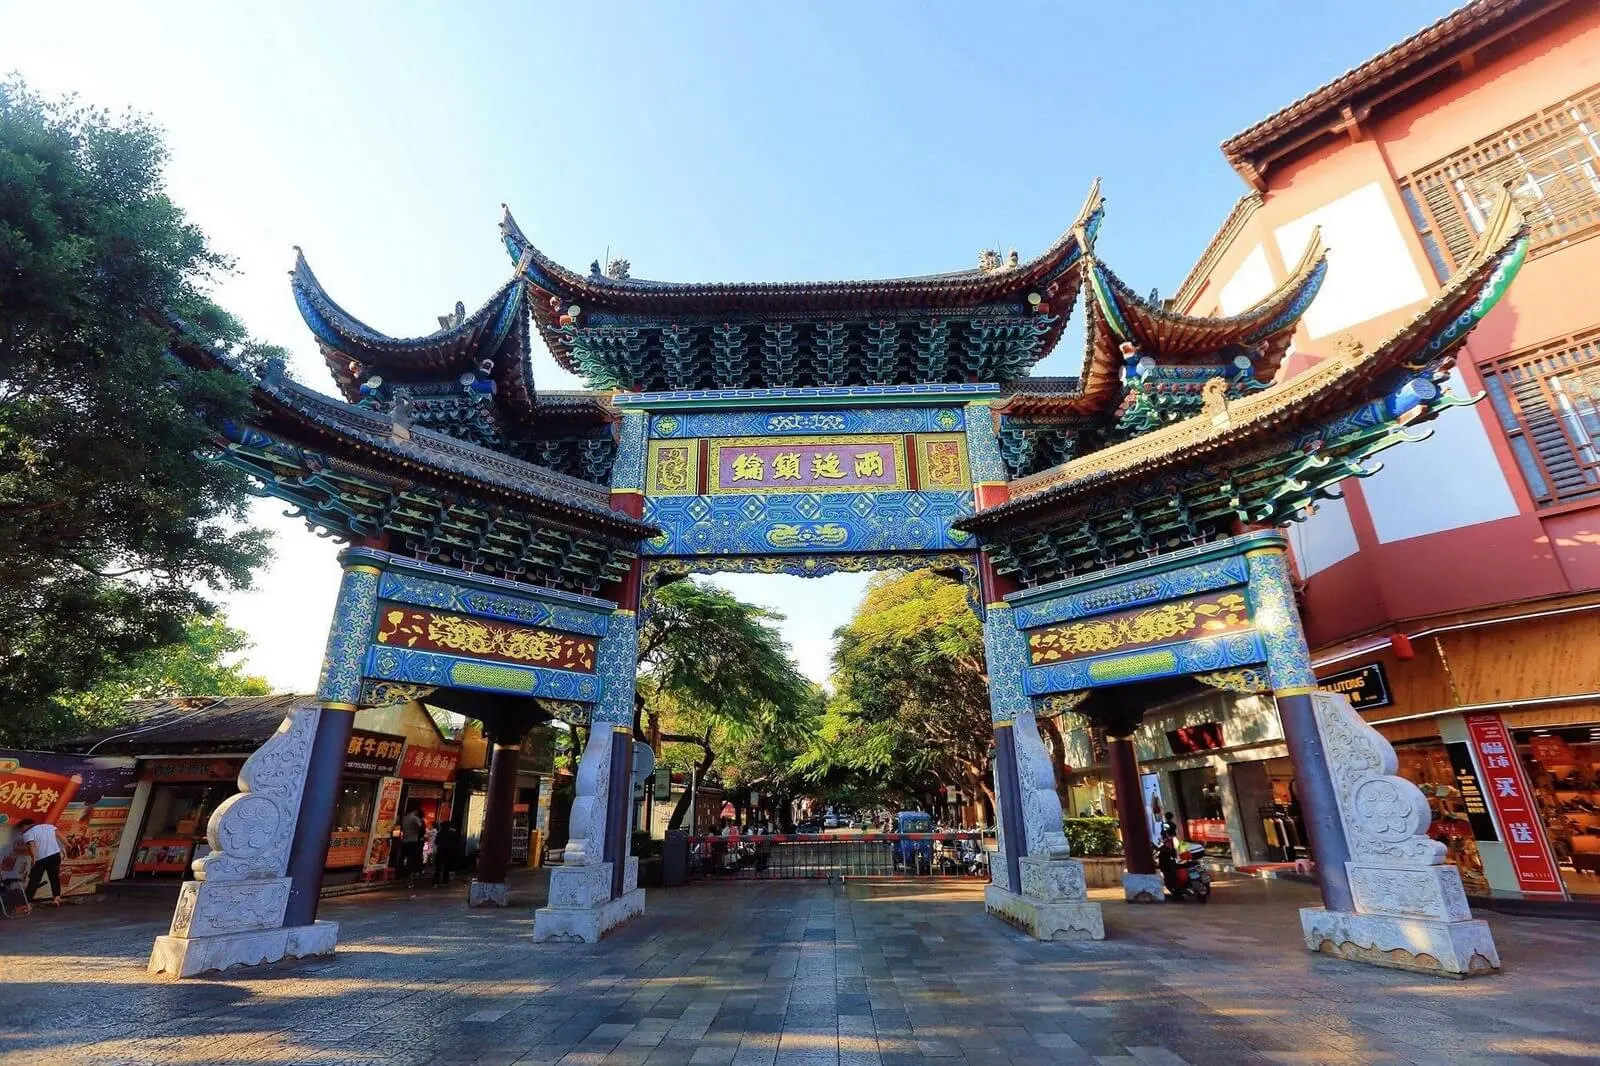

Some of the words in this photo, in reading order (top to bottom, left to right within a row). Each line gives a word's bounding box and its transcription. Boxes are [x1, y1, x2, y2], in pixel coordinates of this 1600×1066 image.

[1487, 755, 1511, 769] 上市
[1494, 777, 1540, 859] 买一送一
